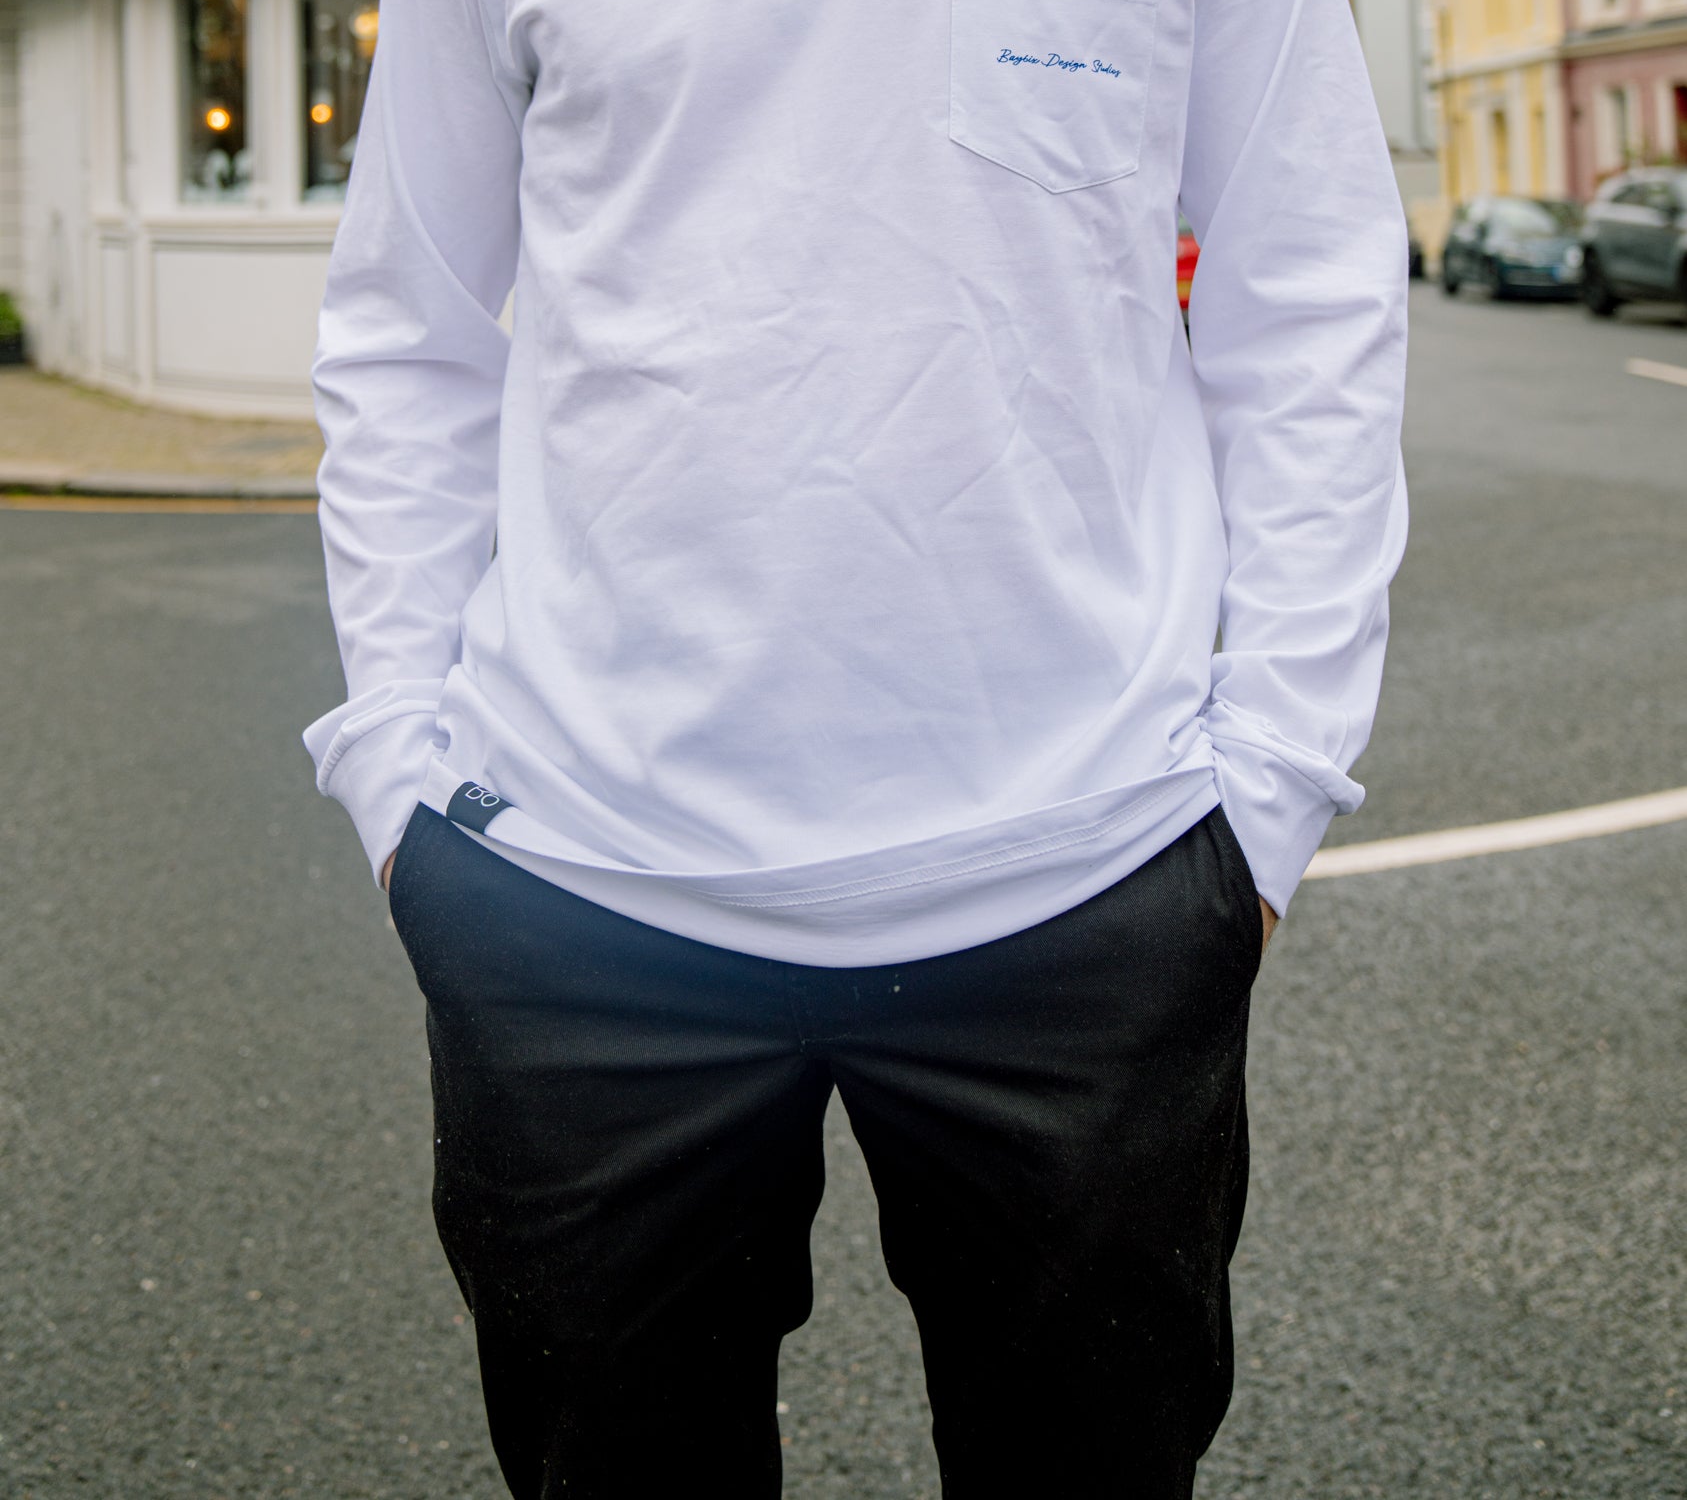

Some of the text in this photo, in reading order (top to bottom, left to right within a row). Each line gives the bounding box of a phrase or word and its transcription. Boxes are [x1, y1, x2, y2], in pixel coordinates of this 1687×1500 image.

[997, 49, 1121, 78] Baybix Design Studios
